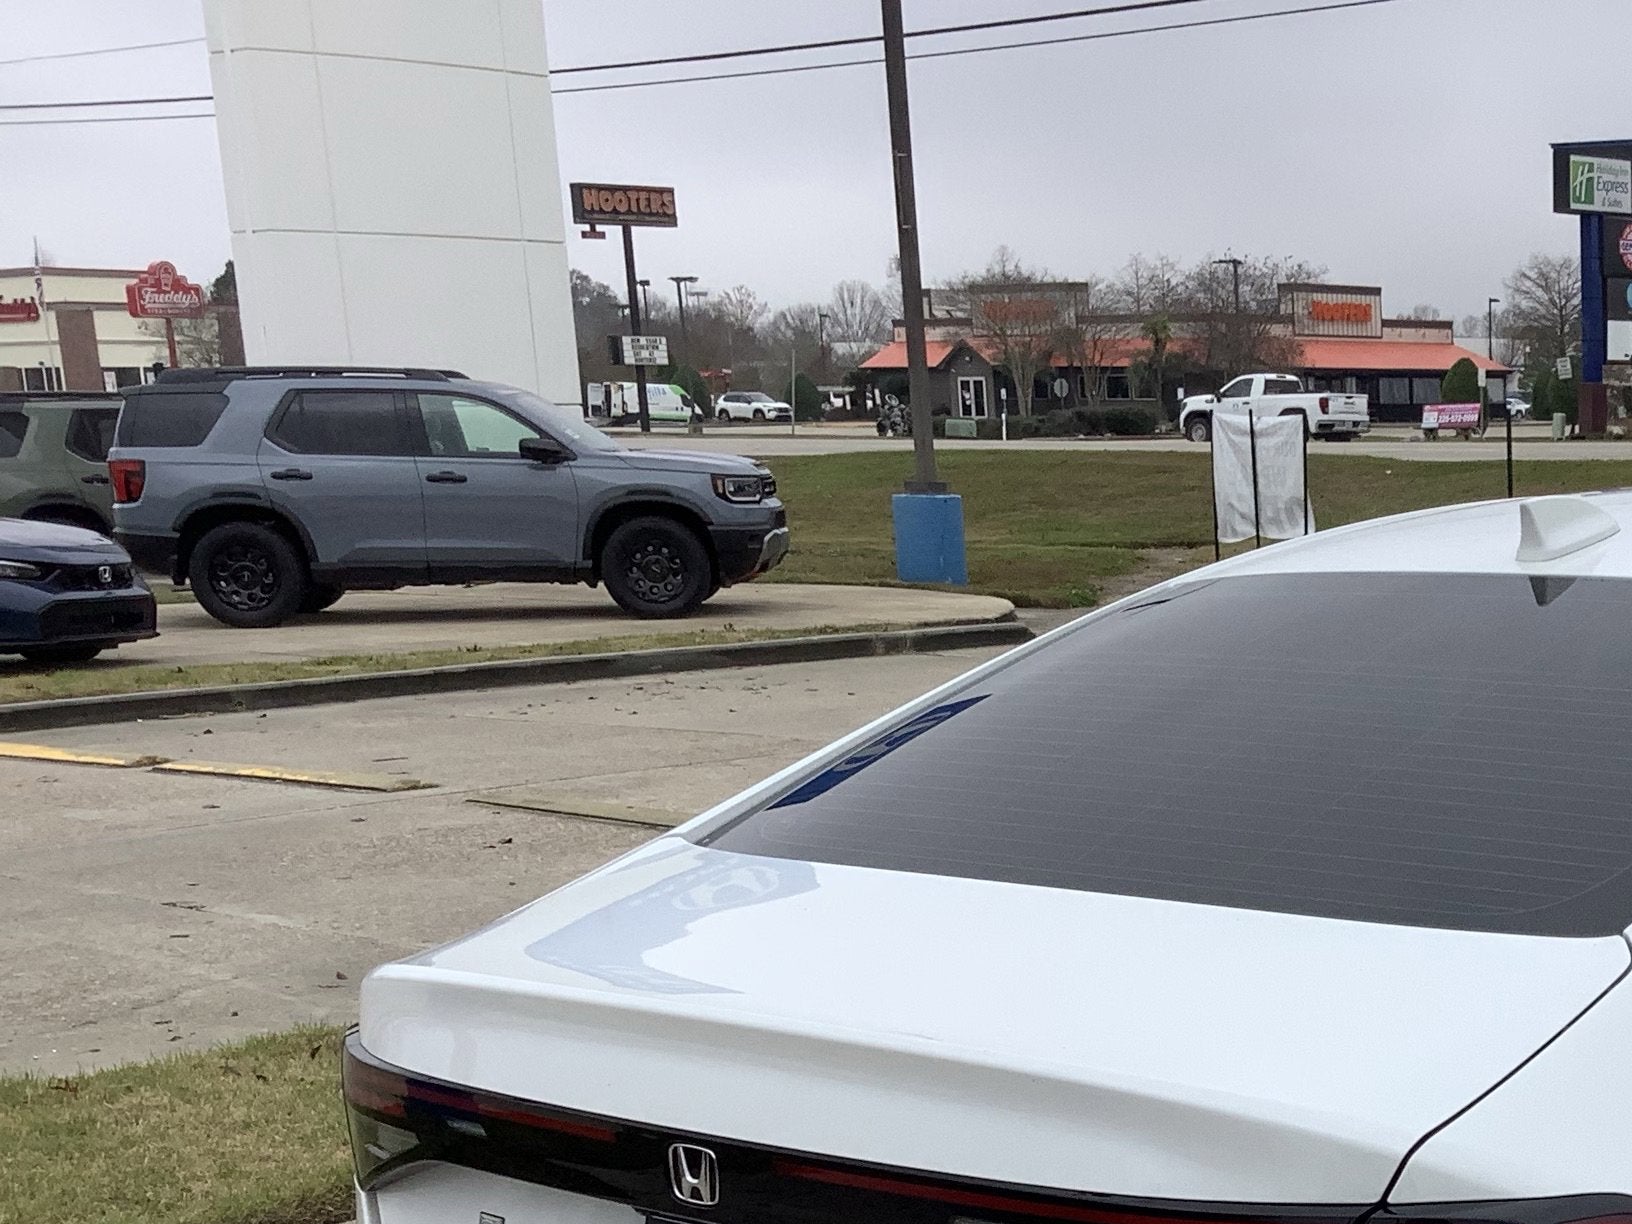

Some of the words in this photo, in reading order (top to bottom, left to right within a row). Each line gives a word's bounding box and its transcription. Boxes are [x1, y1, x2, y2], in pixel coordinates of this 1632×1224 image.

[1596, 176, 1629, 195] Express
[582, 187, 675, 214] HOOTERS
[141, 287, 200, 308] Freddy's
